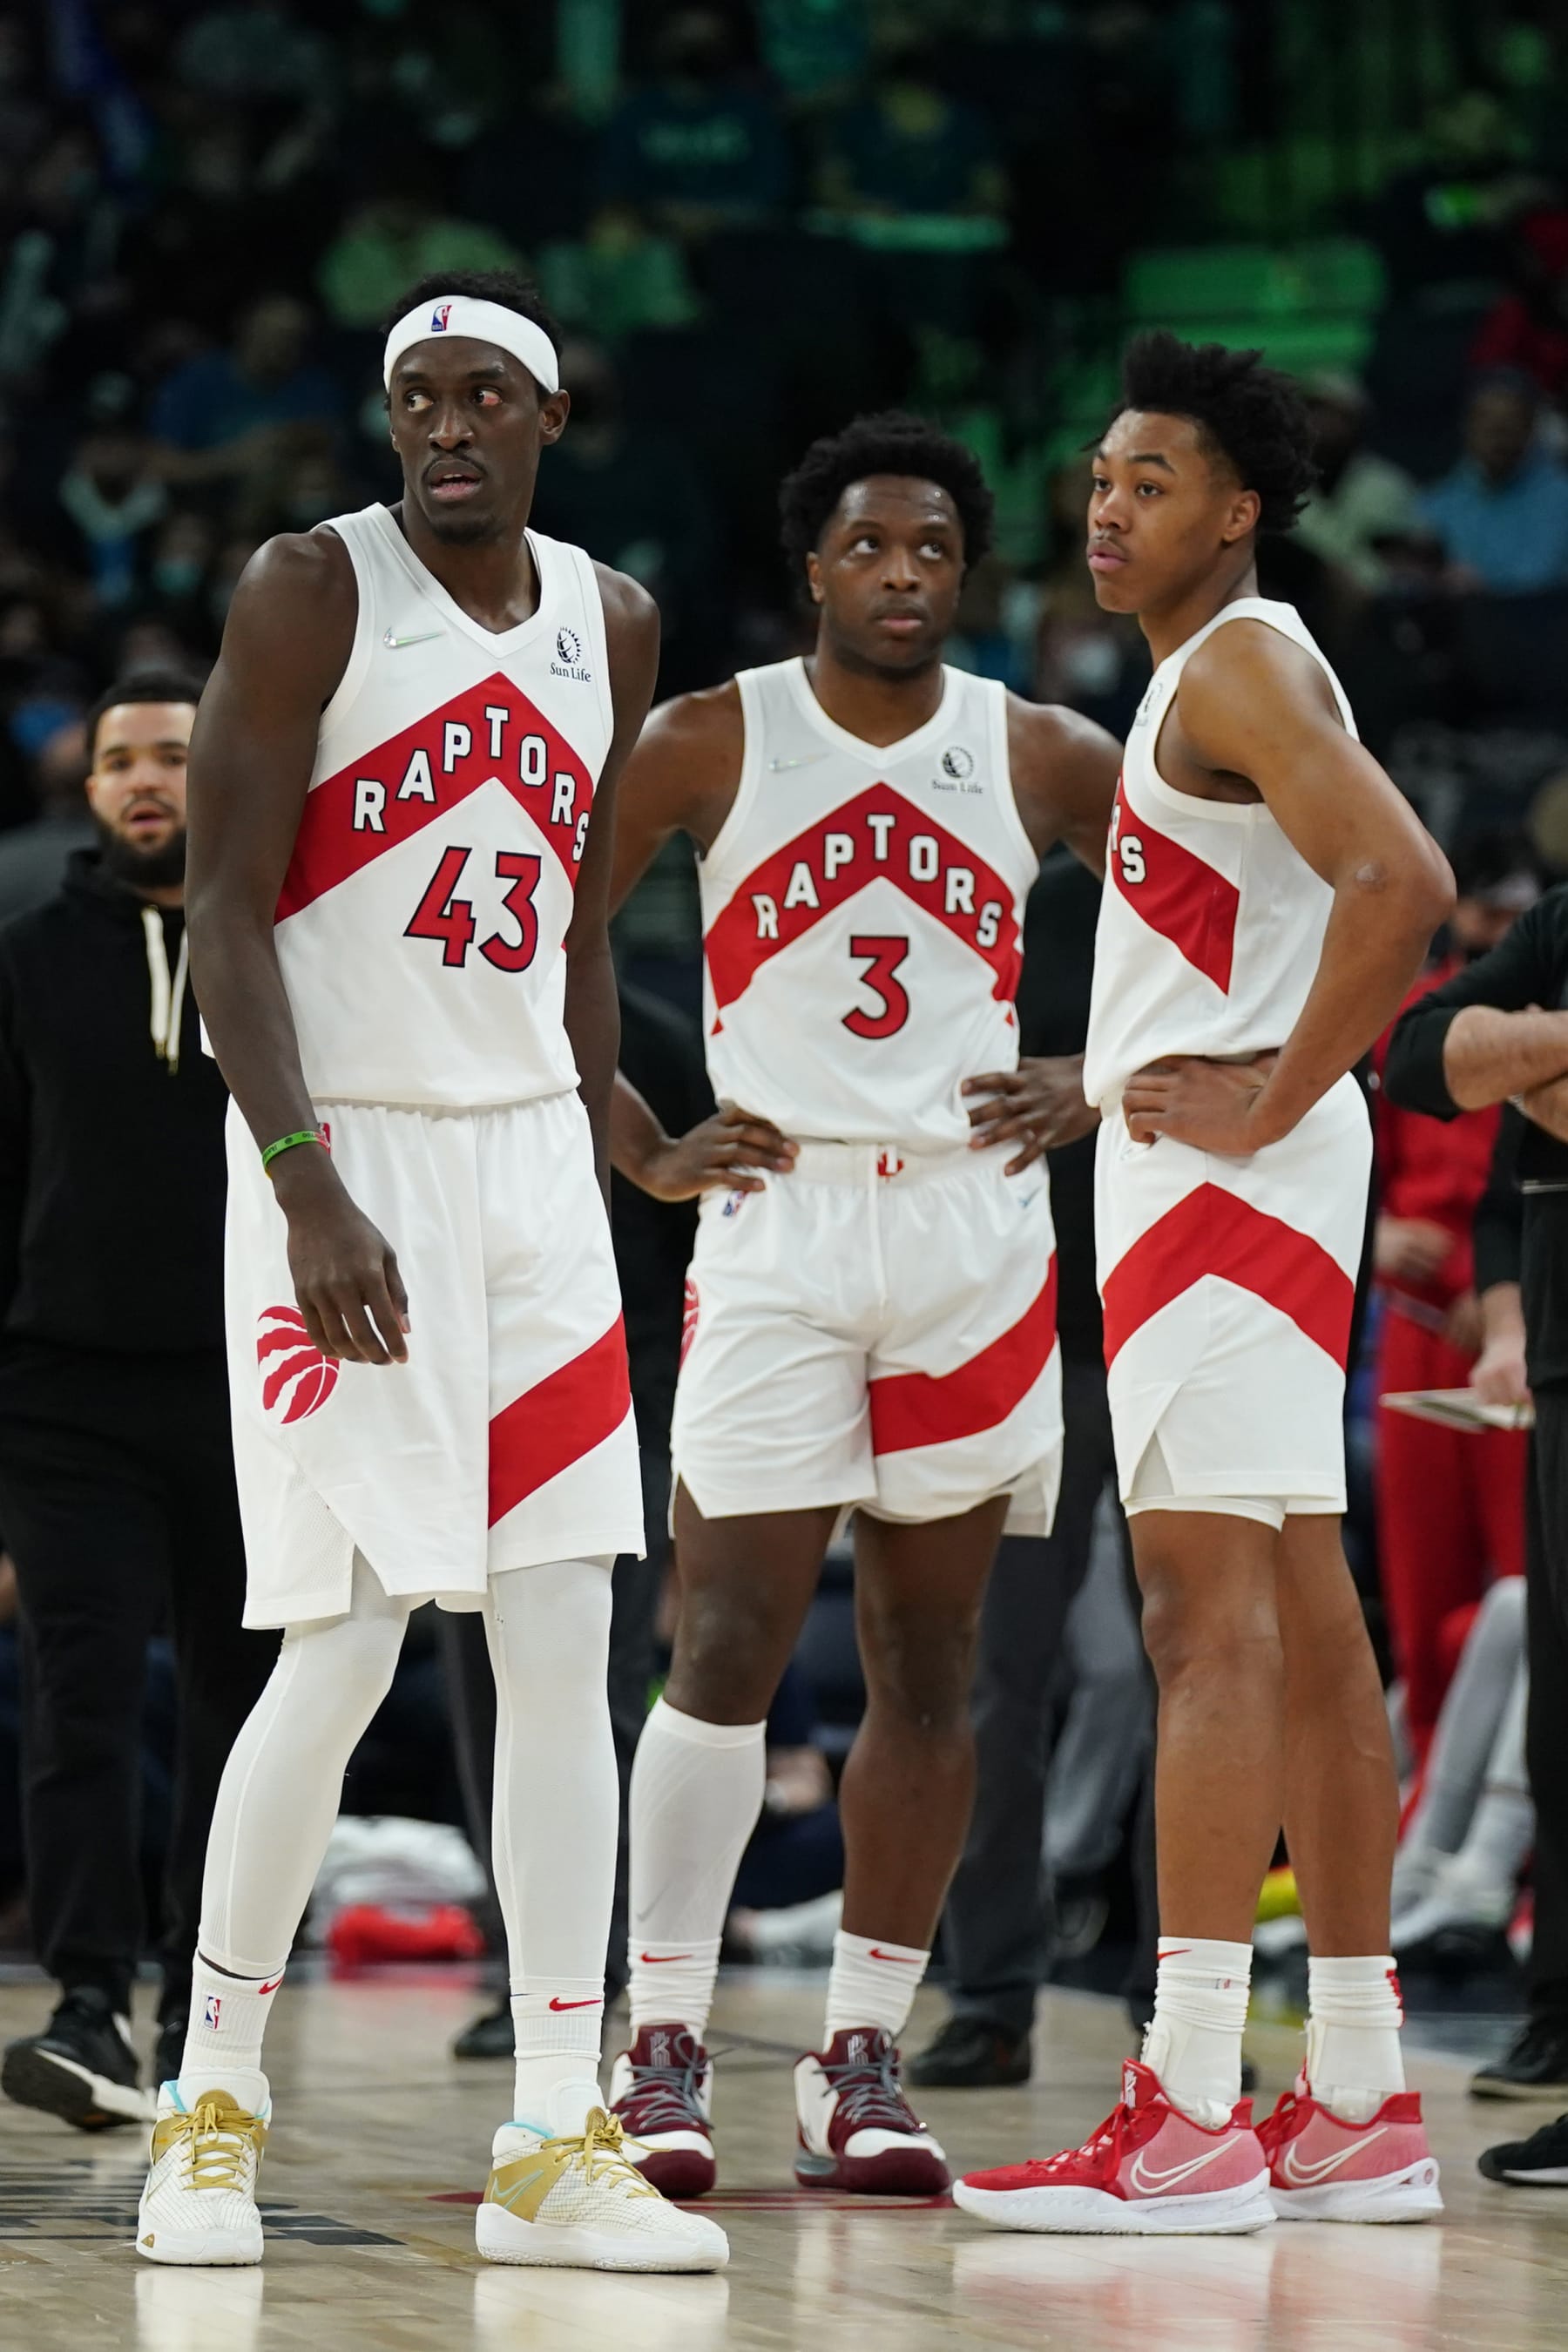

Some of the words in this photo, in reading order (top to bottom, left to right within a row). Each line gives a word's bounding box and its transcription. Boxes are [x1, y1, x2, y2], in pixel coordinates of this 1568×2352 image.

[550, 662, 570, 678] Sun
[571, 667, 591, 682] Life
[352, 705, 589, 862] RAPTORS
[402, 845, 542, 973] 43
[751, 814, 1004, 949] RAPTORS
[841, 935, 909, 1039] 3
